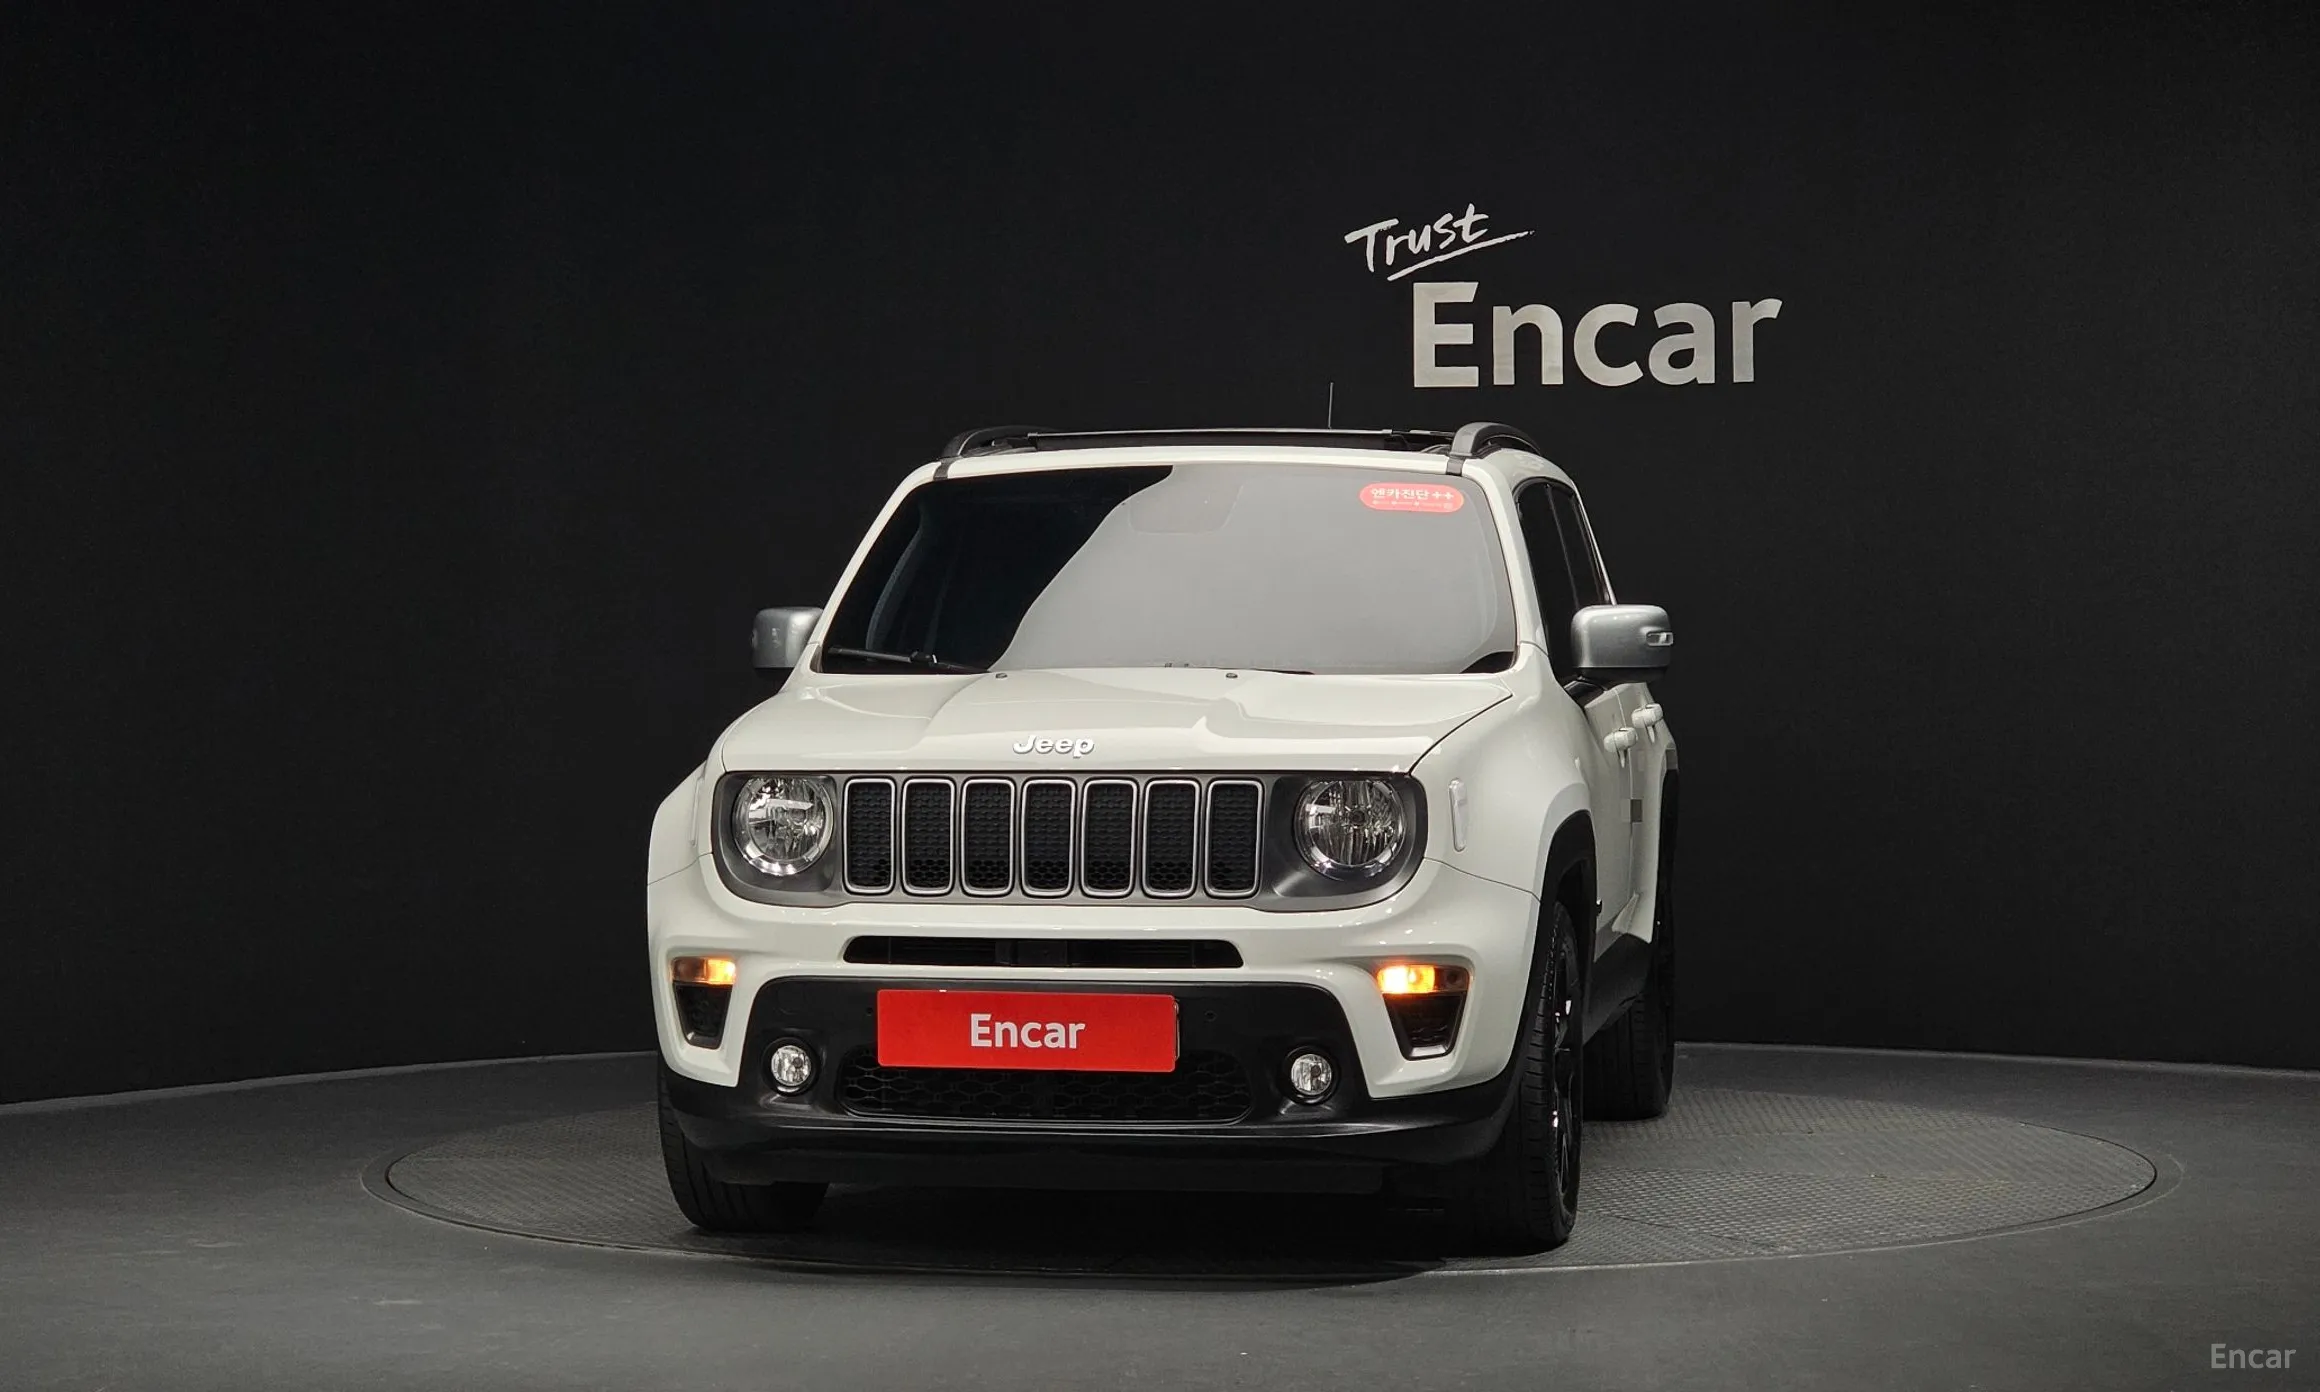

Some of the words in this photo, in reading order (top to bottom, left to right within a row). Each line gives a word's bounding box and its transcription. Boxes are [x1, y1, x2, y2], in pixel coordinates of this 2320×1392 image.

[1344, 203, 1489, 273] Trust
[1413, 281, 1783, 388] Encar
[1012, 734, 1095, 759] Jeep
[970, 1013, 1085, 1049] Encar
